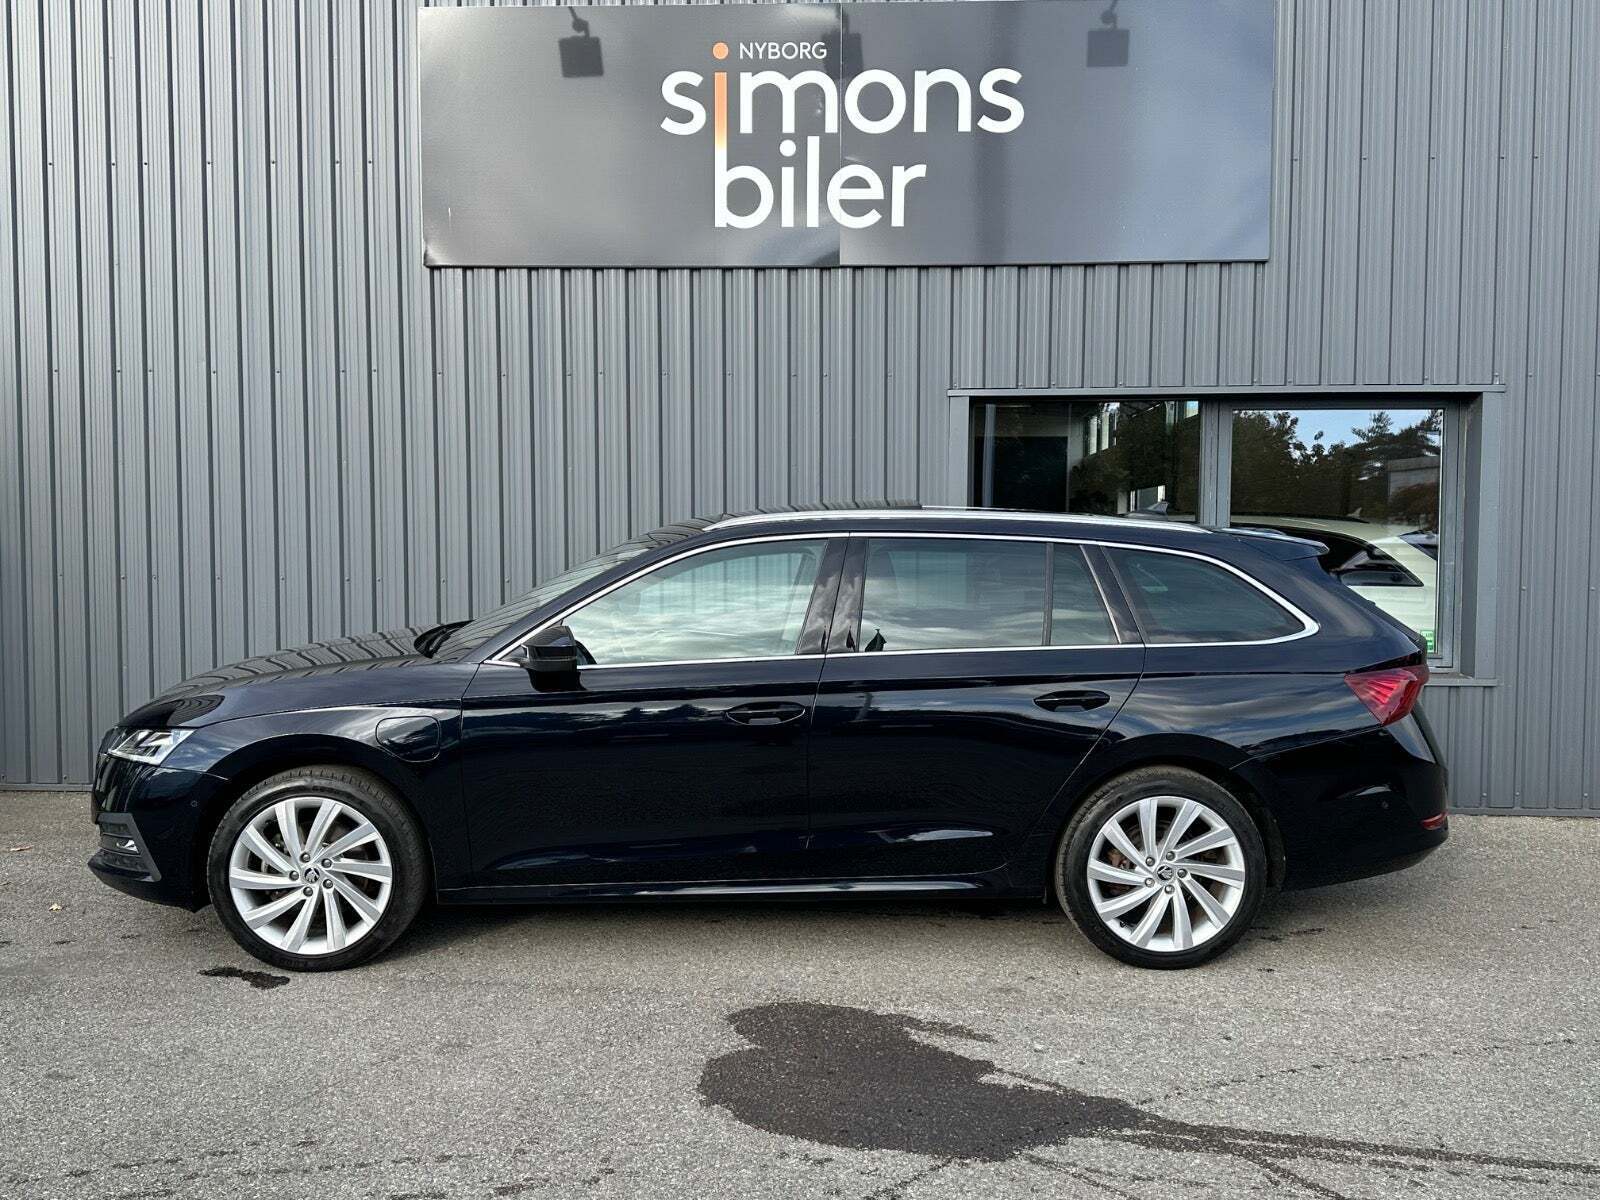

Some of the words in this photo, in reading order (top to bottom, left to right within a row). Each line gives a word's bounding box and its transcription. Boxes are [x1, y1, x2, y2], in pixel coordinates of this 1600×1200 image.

[660, 42, 1025, 136] simons
[738, 42, 828, 60] NYBORG
[714, 135, 927, 229] biler
